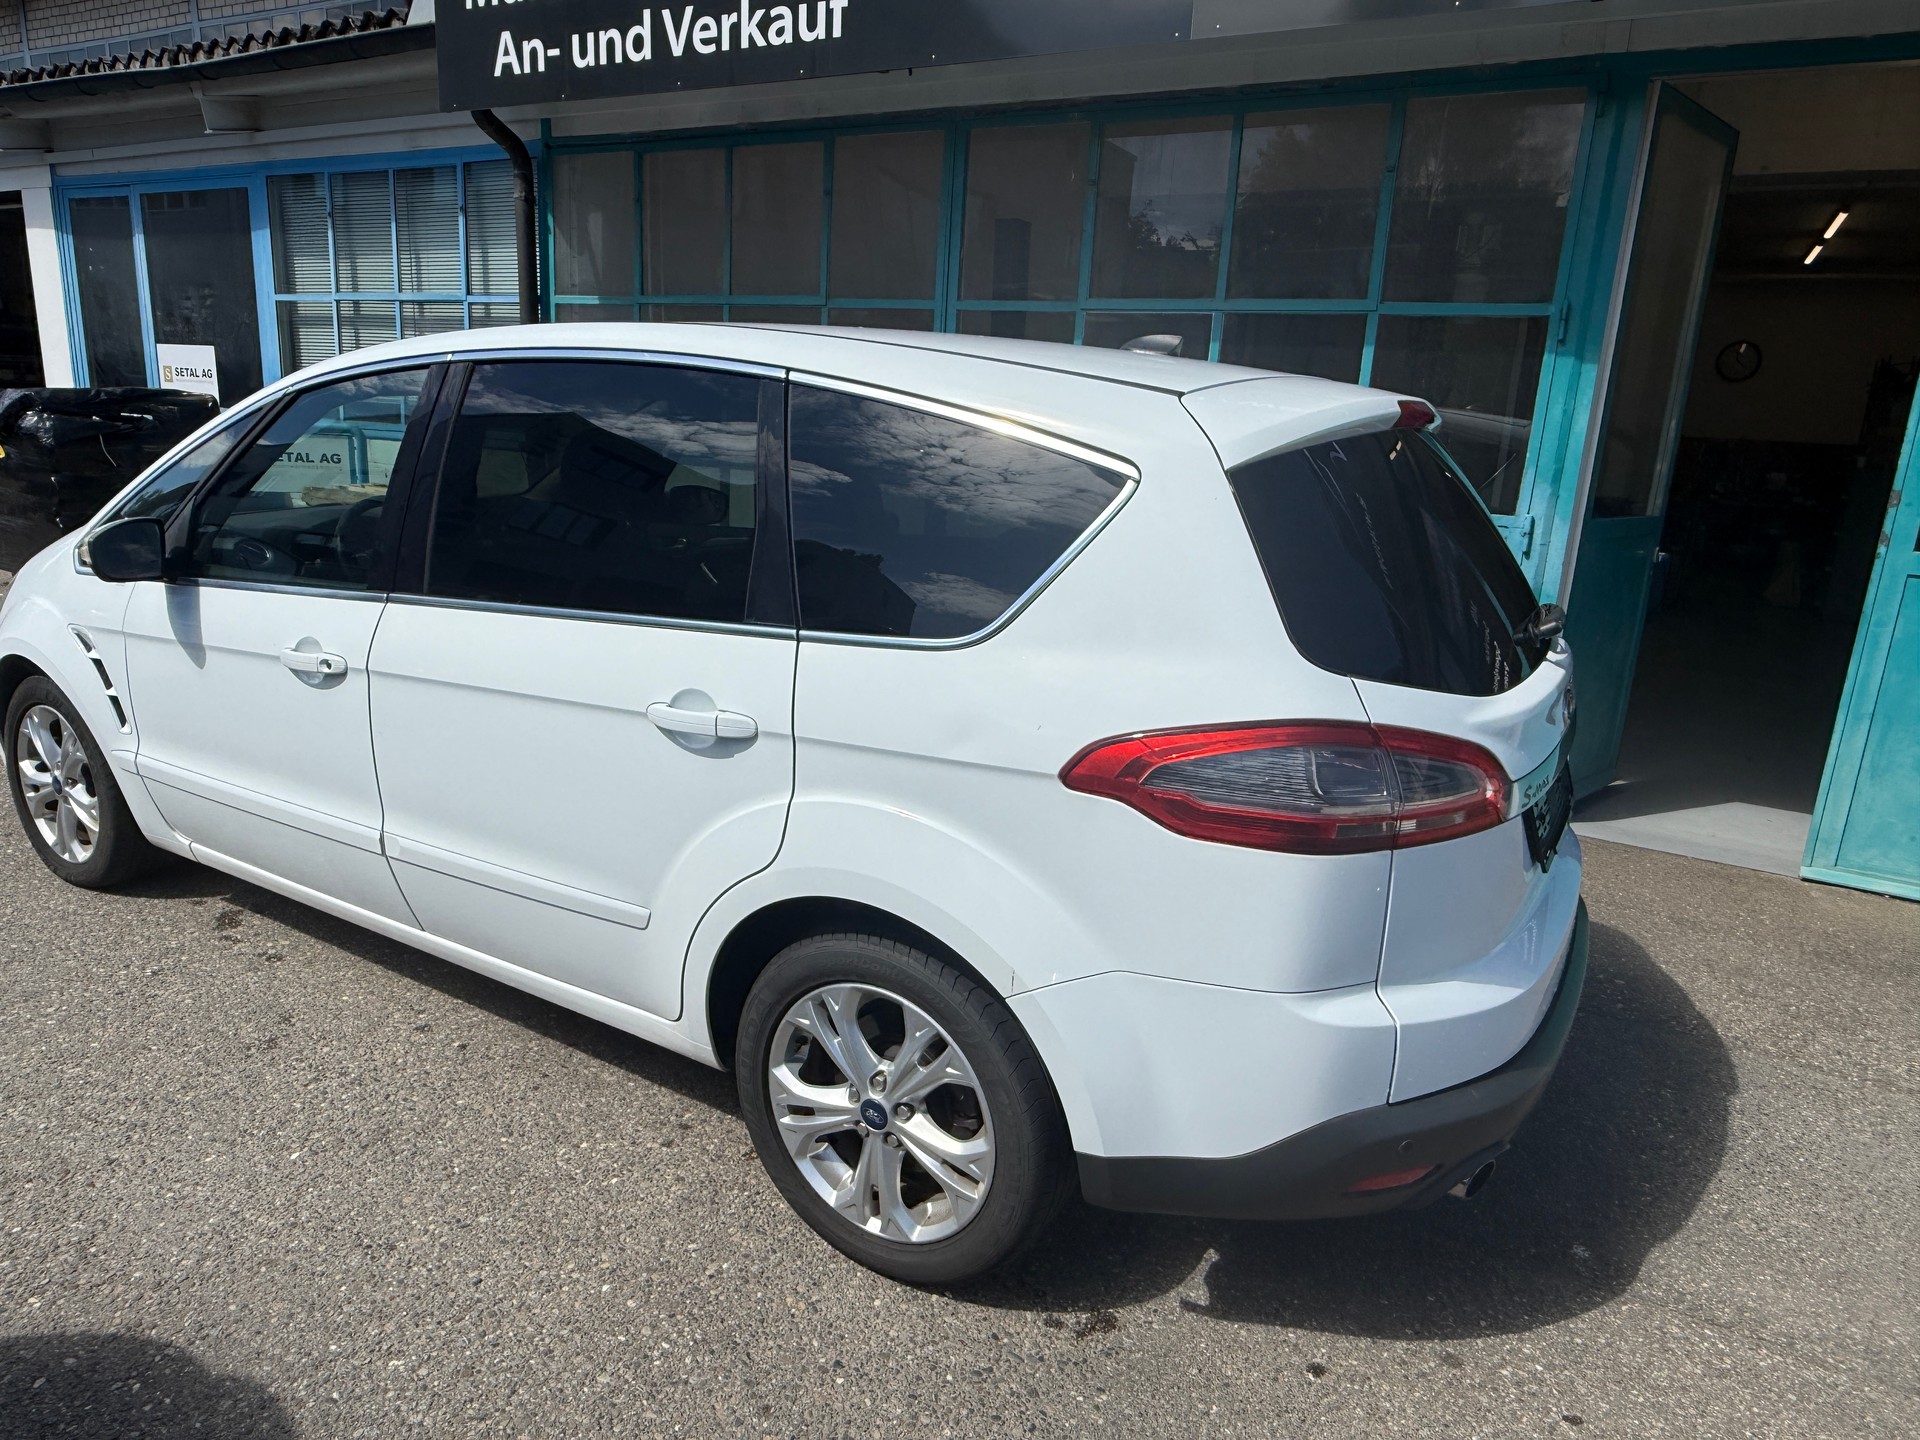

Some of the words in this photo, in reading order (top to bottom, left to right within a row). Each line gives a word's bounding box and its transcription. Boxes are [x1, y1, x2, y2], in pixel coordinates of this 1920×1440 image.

[494, 30, 561, 77] An-
[571, 8, 653, 69] und
[661, 0, 848, 55] Verkauf
[174, 366, 200, 378] SETAL
[201, 368, 213, 379] AG
[276, 451, 315, 463] TAL
[319, 452, 342, 464] AG
